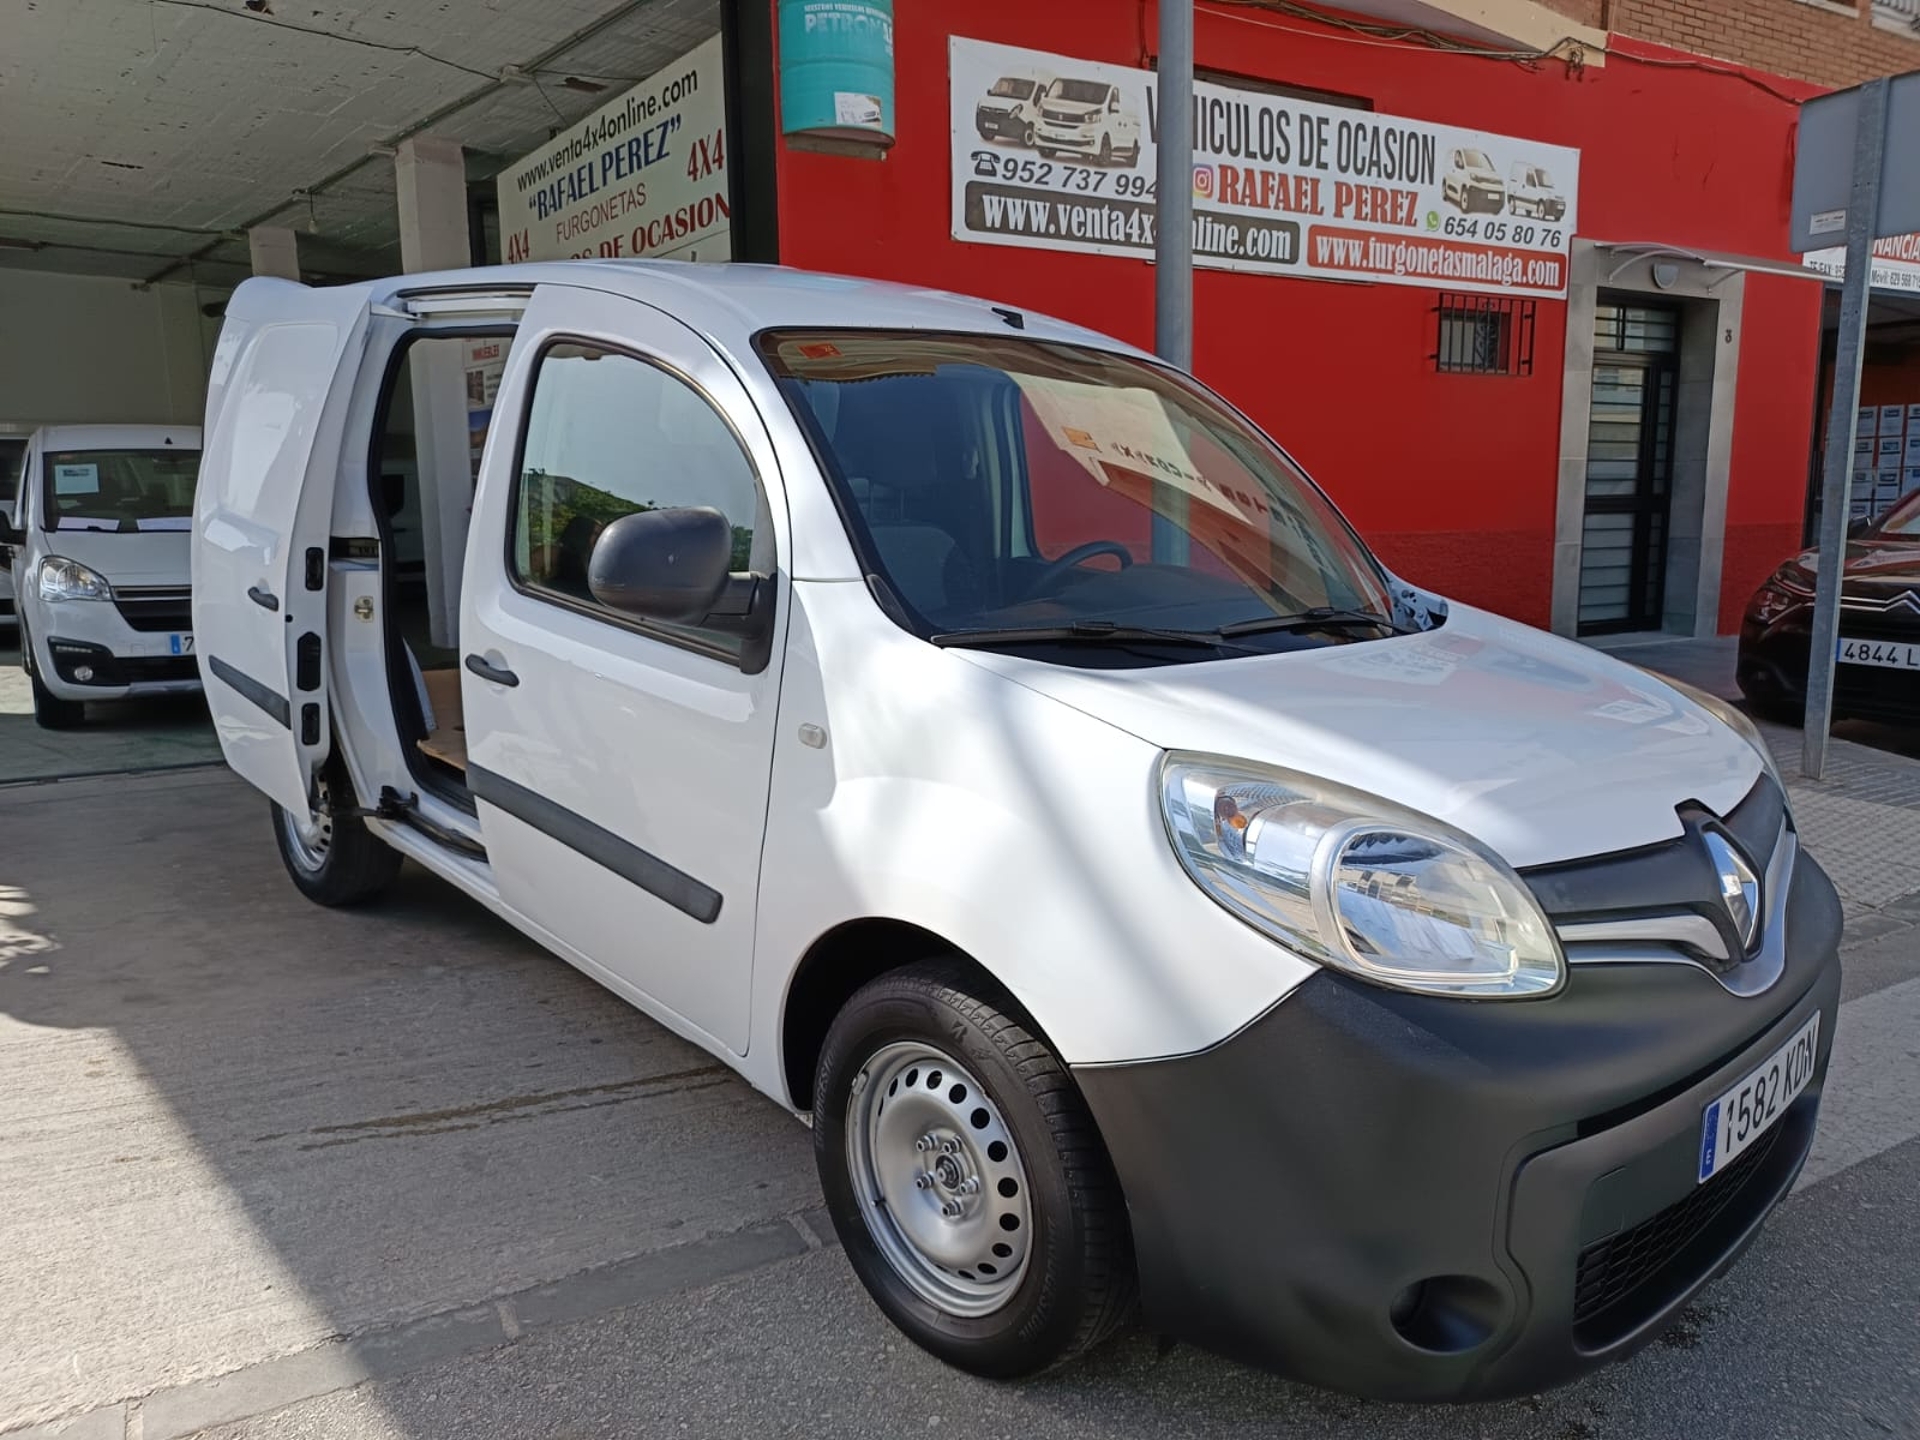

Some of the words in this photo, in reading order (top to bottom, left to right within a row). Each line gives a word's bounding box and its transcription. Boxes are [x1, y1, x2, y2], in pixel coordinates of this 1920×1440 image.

[517, 69, 698, 192] www.venta4x4online.com
[687, 128, 724, 183] 4X4
[1299, 113, 1330, 170] DE
[1337, 119, 1436, 185] OCASION
[1001, 157, 1051, 186] 952
[1060, 165, 1108, 193] 737
[1217, 163, 1324, 216] RAFAEL
[1333, 180, 1418, 228] PEREZ
[556, 182, 647, 245] FURGONETAS
[632, 192, 731, 254] OCASION
[1444, 216, 1478, 238] 654
[1484, 221, 1507, 241] 05
[1512, 225, 1535, 245] 80
[1540, 228, 1562, 248] 76
[508, 227, 530, 264] 4X4
[1316, 233, 1559, 287] www.furgonetasmalaga.com
[184, 635, 194, 652] 7
[1844, 642, 1899, 666] 4844
[1906, 648, 1919, 666] L
[1726, 1064, 1779, 1153] 1582
[1783, 1024, 1816, 1102] KDN
